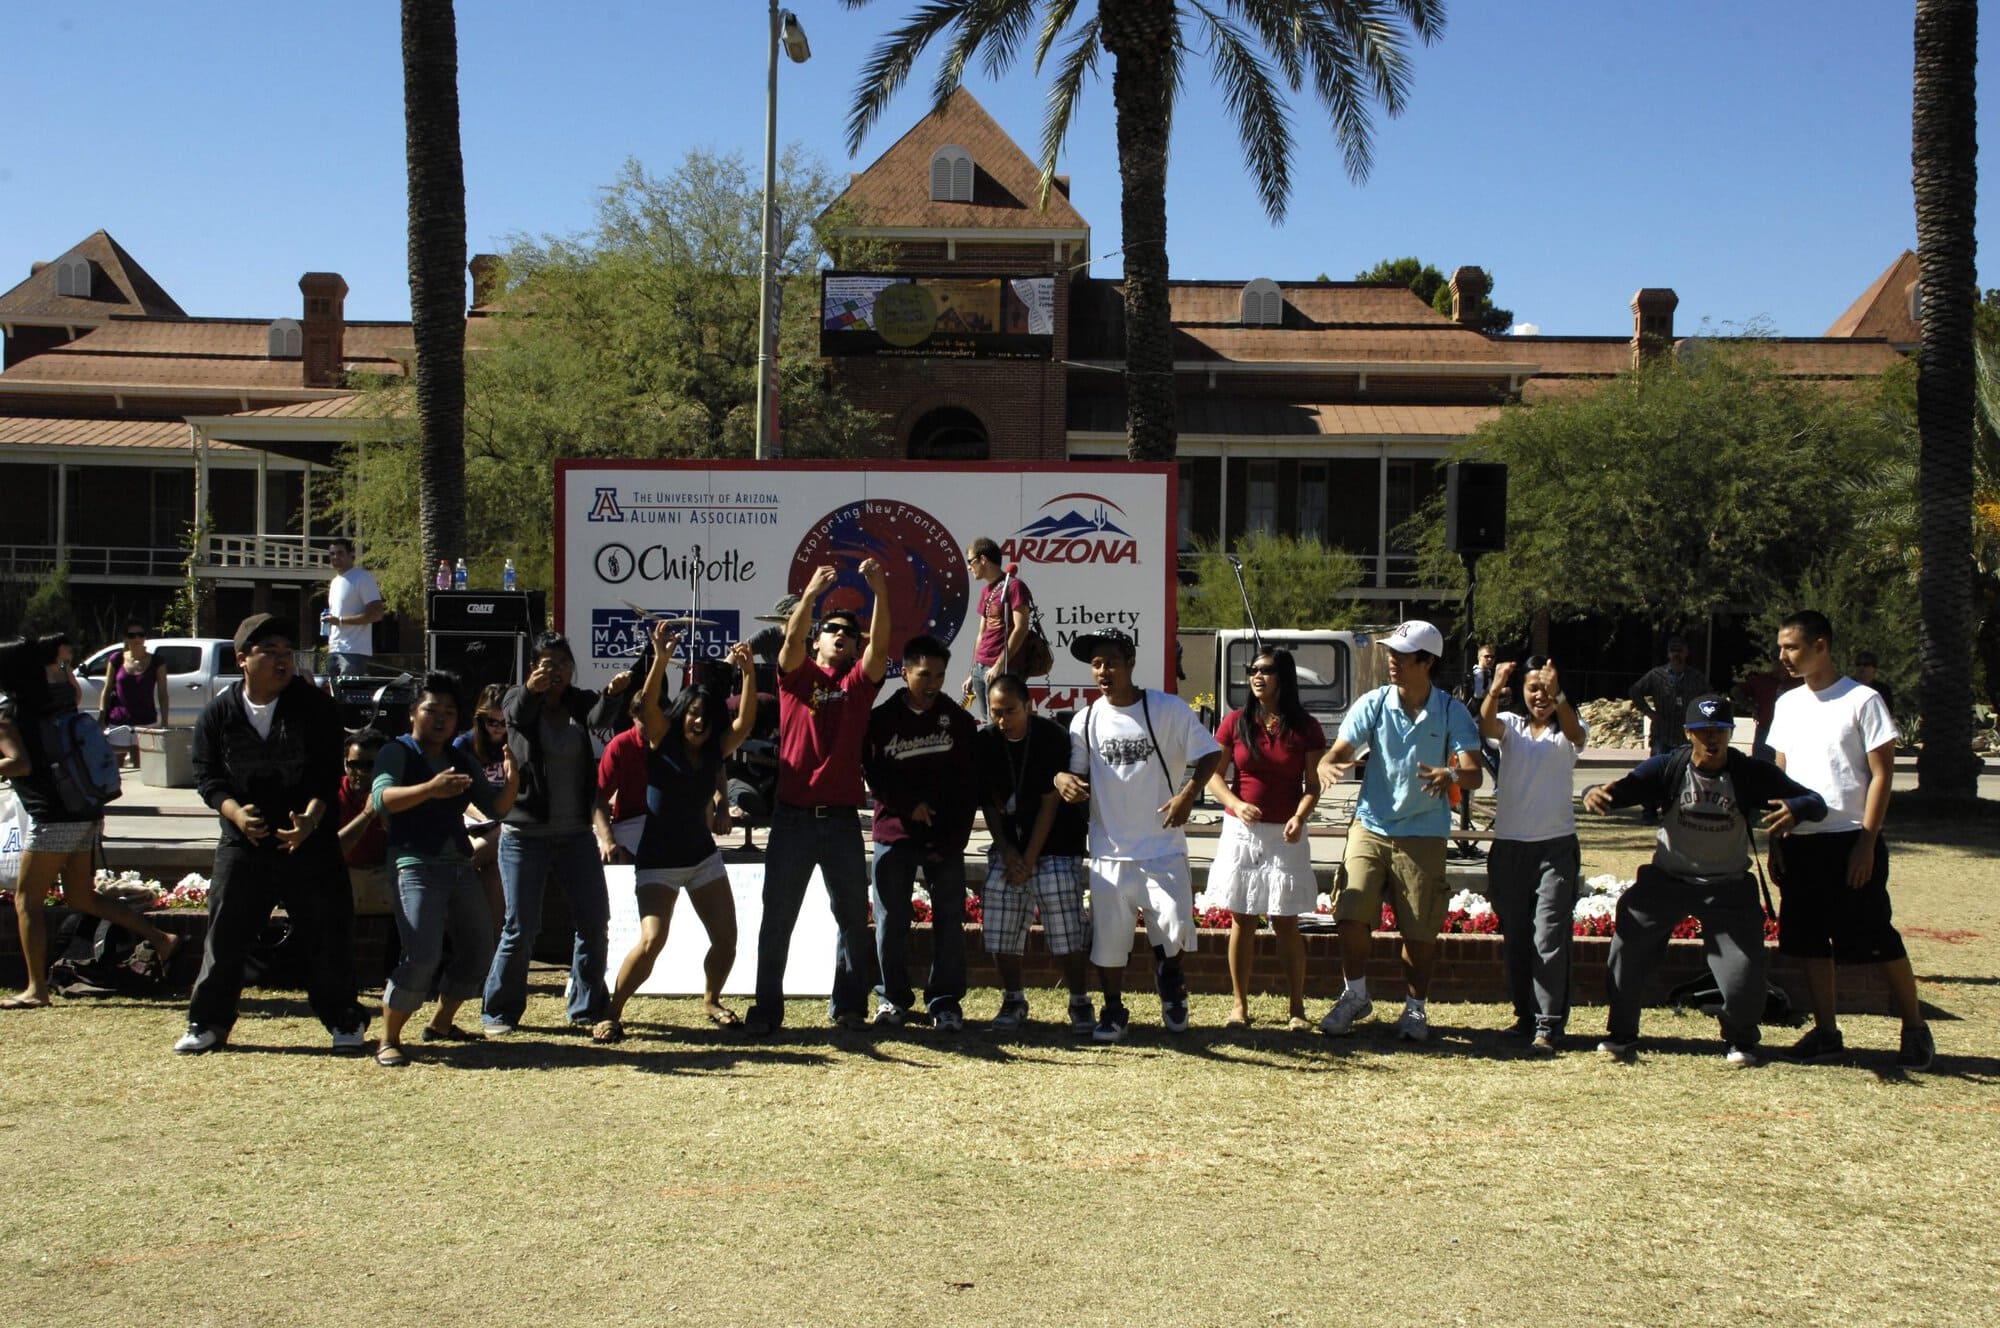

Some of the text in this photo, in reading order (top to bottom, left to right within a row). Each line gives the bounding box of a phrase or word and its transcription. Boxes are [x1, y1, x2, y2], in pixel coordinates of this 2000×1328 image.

[588, 487, 624, 522] A
[633, 491, 778, 504] THE UNIVERSITY OF ARIZONA
[630, 509, 778, 525] ALUMNI ASSOCIATION
[797, 502, 957, 564] Exploring New Frontiers
[1000, 538, 1137, 564] ARIZONA
[638, 544, 757, 592] Chipotle
[1055, 605, 1141, 629] Liberty
[594, 629, 737, 643] MARALL
[594, 643, 735, 657] FOUATIO
[592, 662, 631, 670] TUCS
[2, 827, 21, 853] A
